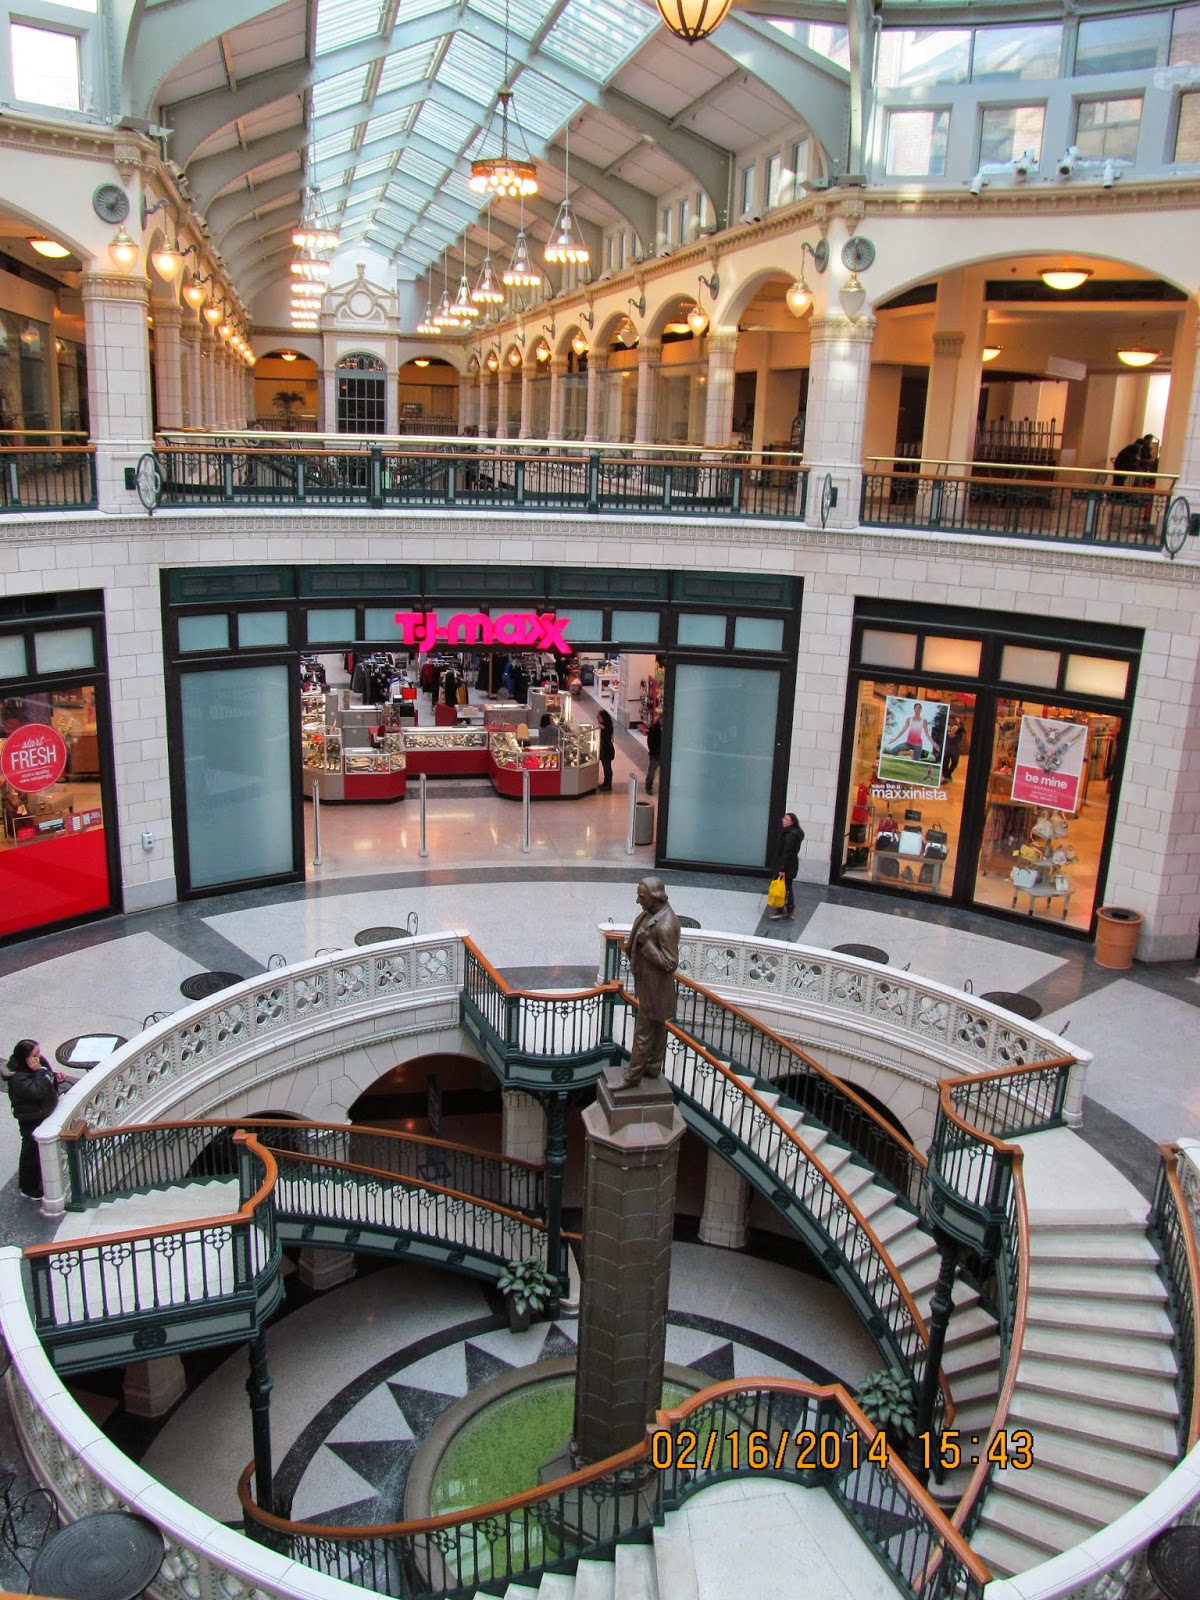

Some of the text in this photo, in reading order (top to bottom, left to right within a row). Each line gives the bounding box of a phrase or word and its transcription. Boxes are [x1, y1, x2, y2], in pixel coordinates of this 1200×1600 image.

[21, 736, 45, 749] start
[11, 744, 57, 770] FRESH
[1025, 771, 1068, 789] be mine
[872, 787, 948, 801] maxxinista
